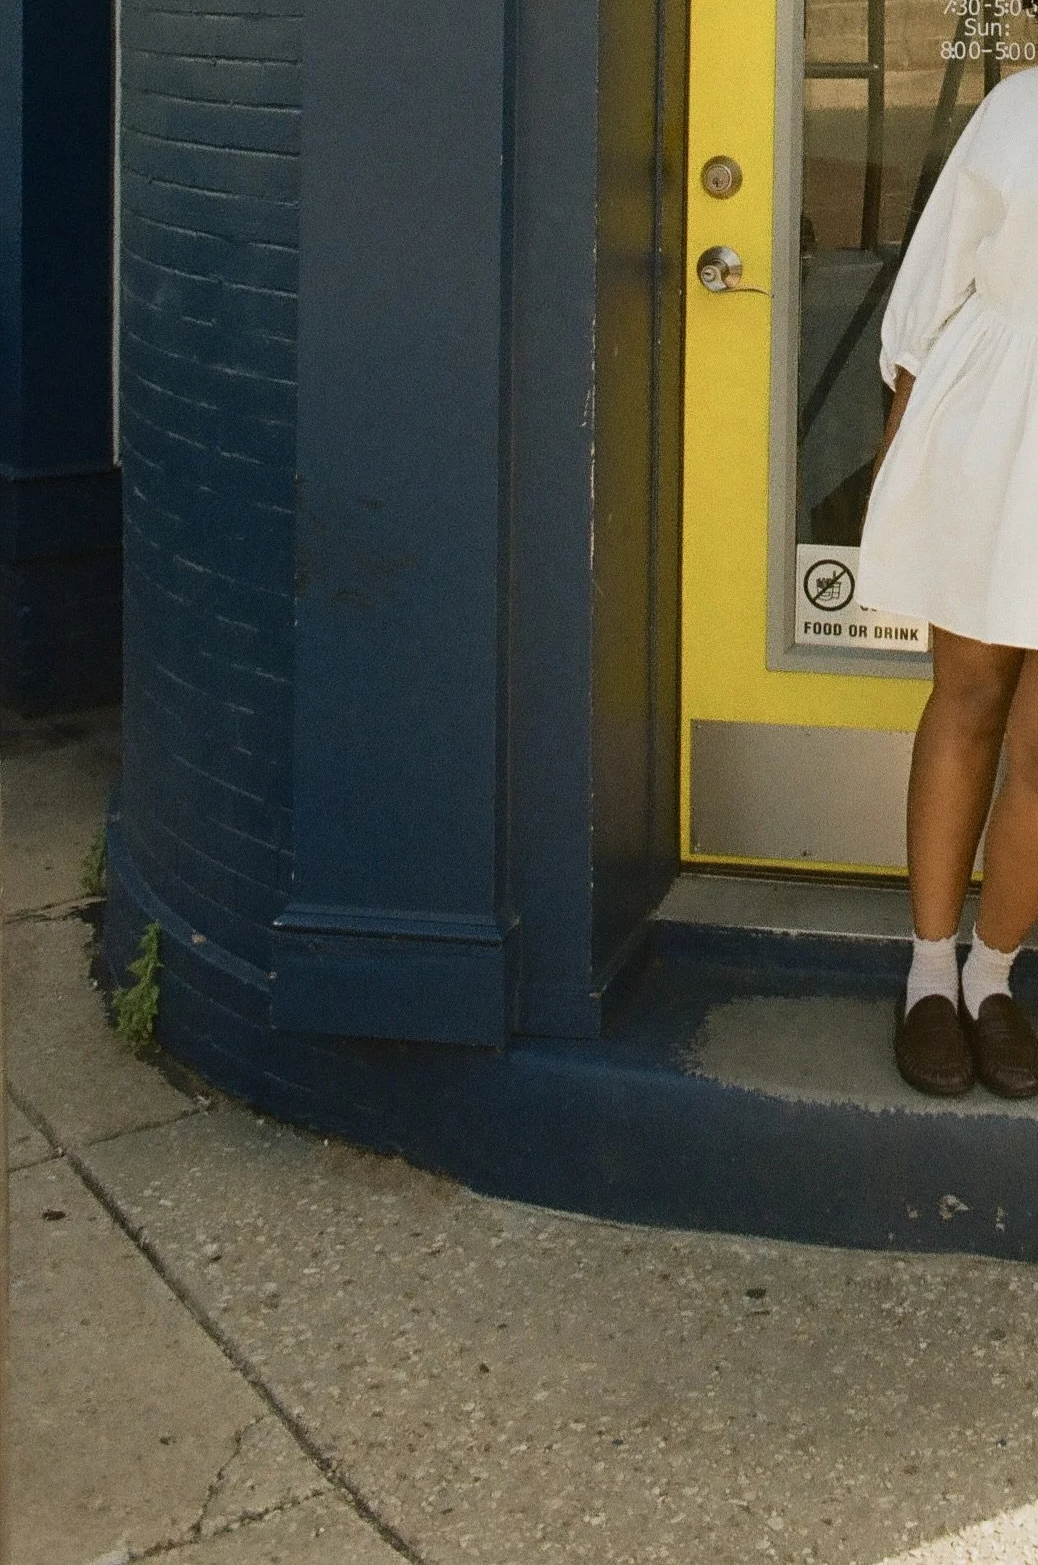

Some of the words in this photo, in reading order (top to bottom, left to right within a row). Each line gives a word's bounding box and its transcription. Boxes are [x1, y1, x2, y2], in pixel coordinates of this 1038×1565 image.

[964, 18, 1010, 36] Sun:
[803, 621, 842, 636] FOOD
[848, 624, 868, 638] OR
[873, 626, 919, 641] DRINK
